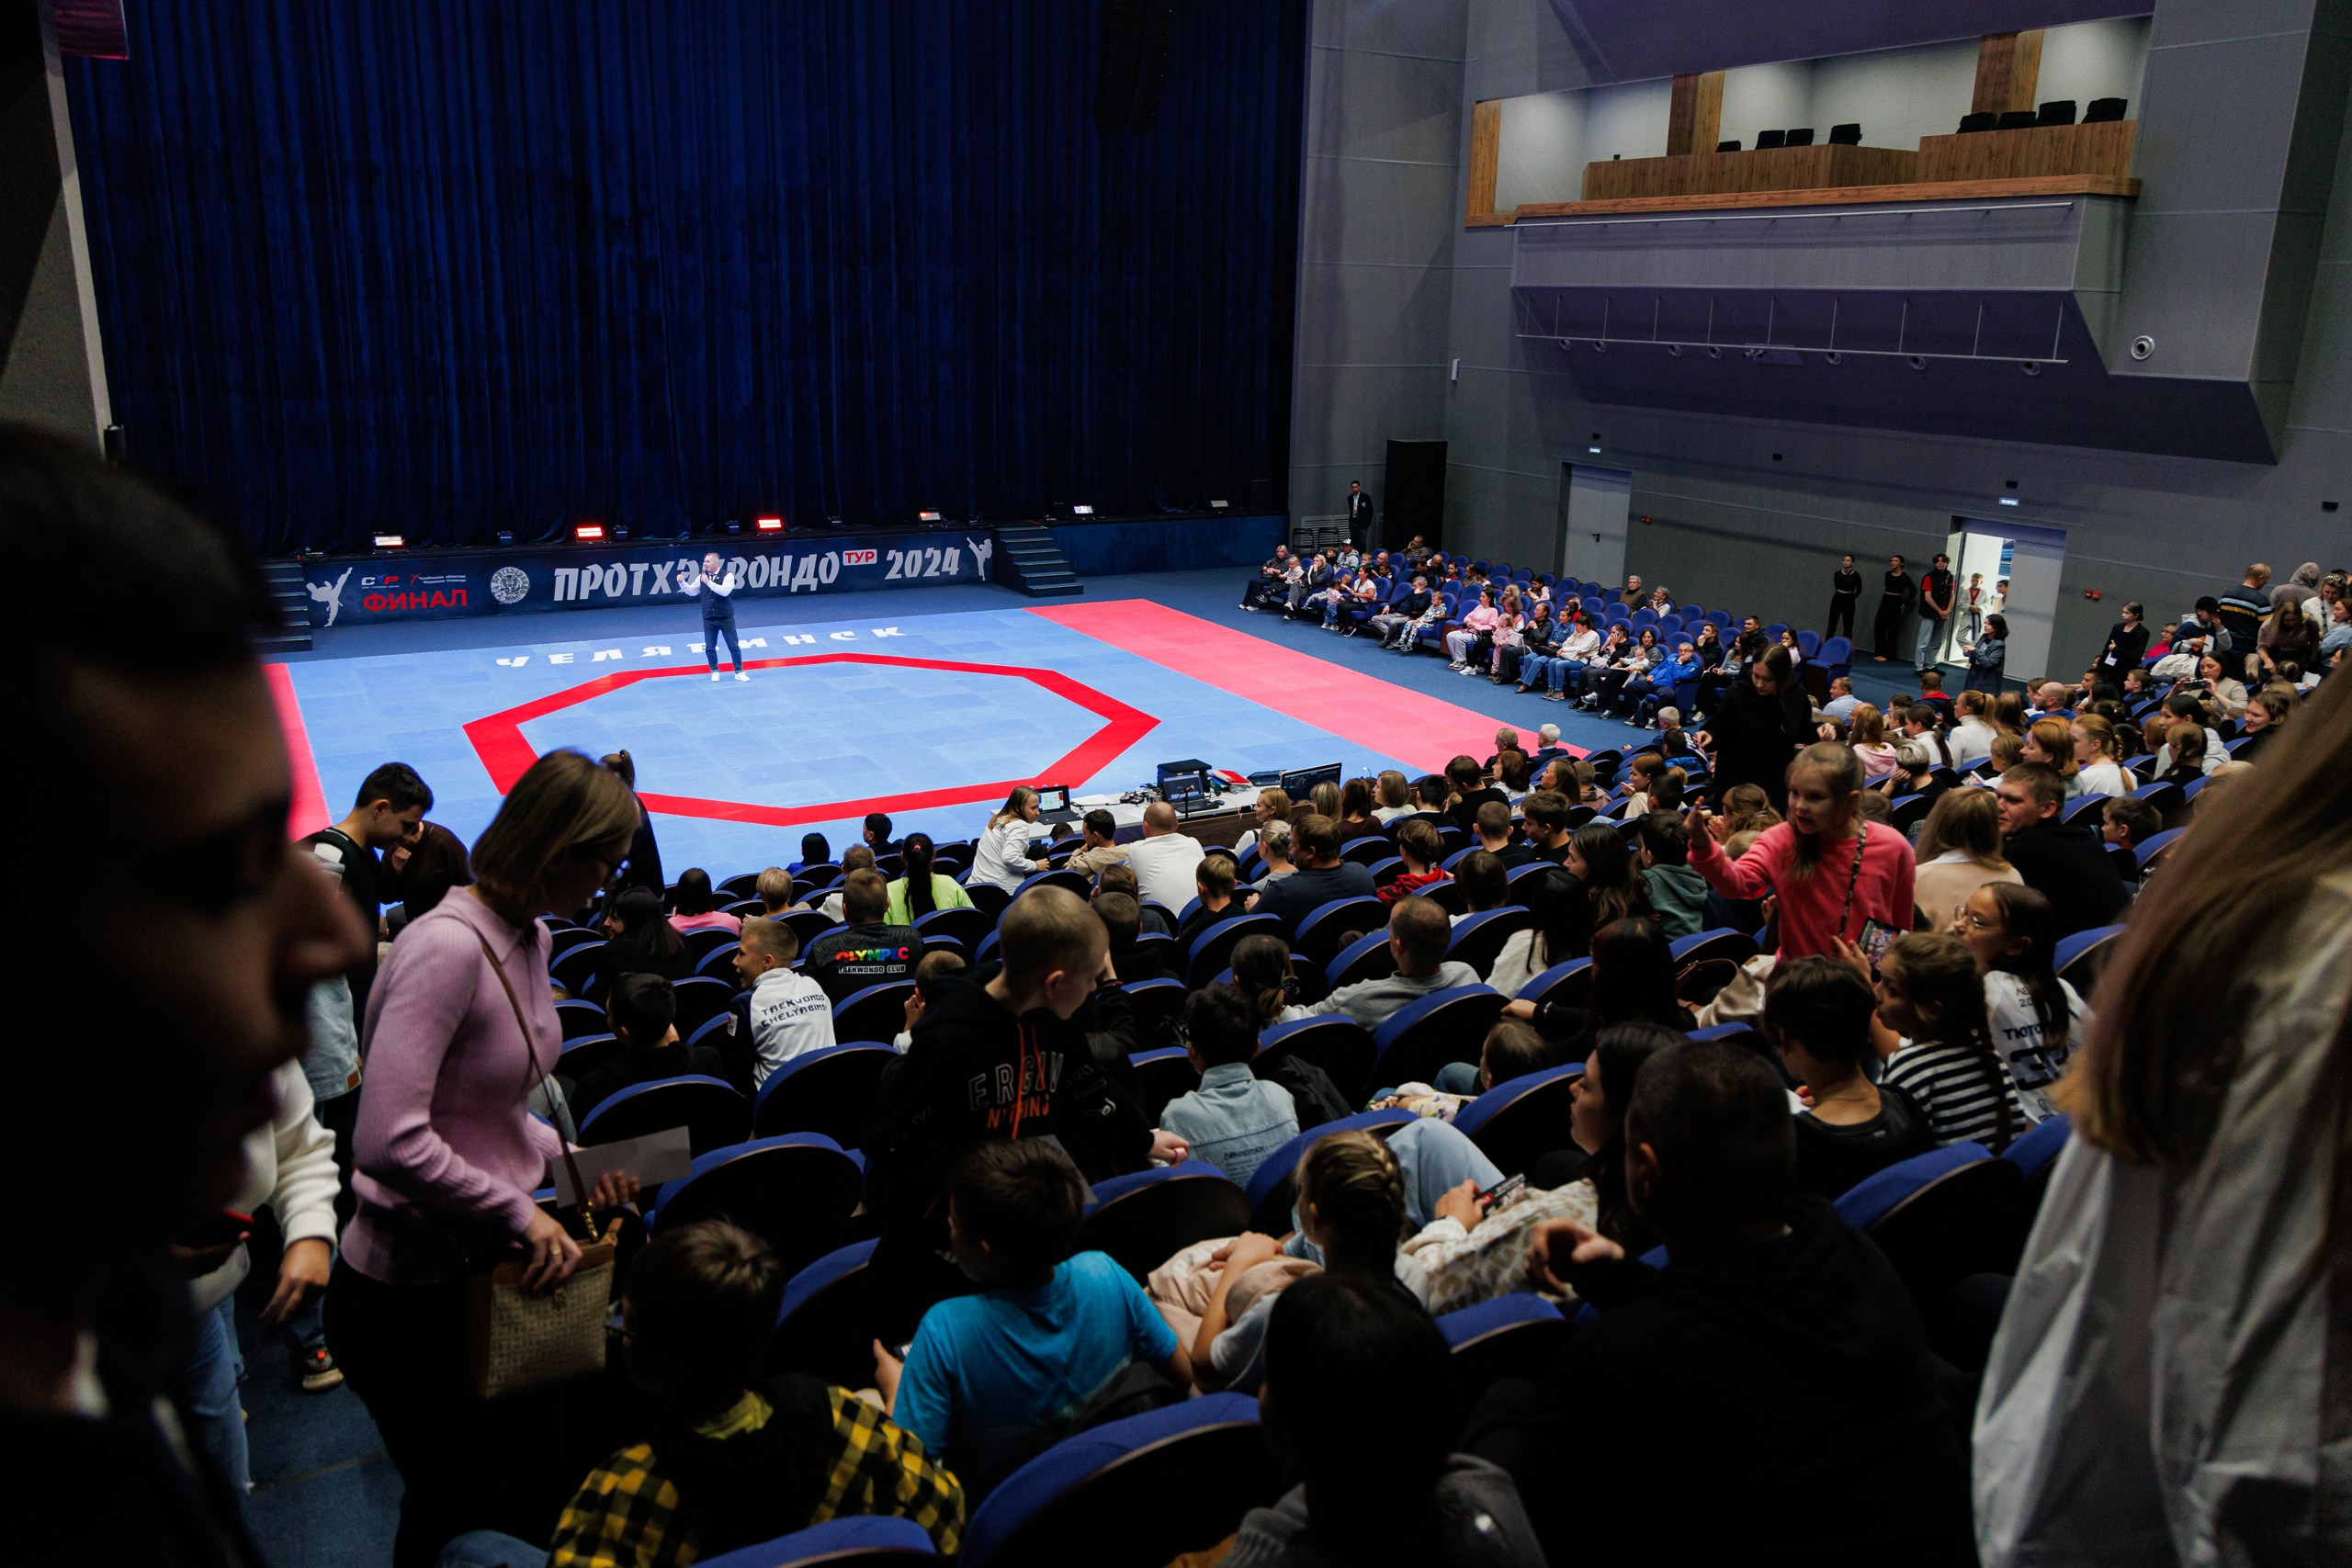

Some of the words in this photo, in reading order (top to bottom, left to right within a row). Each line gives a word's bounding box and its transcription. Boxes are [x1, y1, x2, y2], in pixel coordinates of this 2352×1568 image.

[844, 550, 876, 564] ТУР
[884, 547, 961, 581] 2024
[553, 551, 840, 601] ПРОТХЭВОНДО
[363, 589, 467, 613] ФИНАЛ
[835, 946, 909, 961] OLYMPIC
[838, 965, 885, 974] TAEKWONDO
[887, 964, 906, 973] CLUB
[761, 1004, 827, 1028] CHELYABINS
